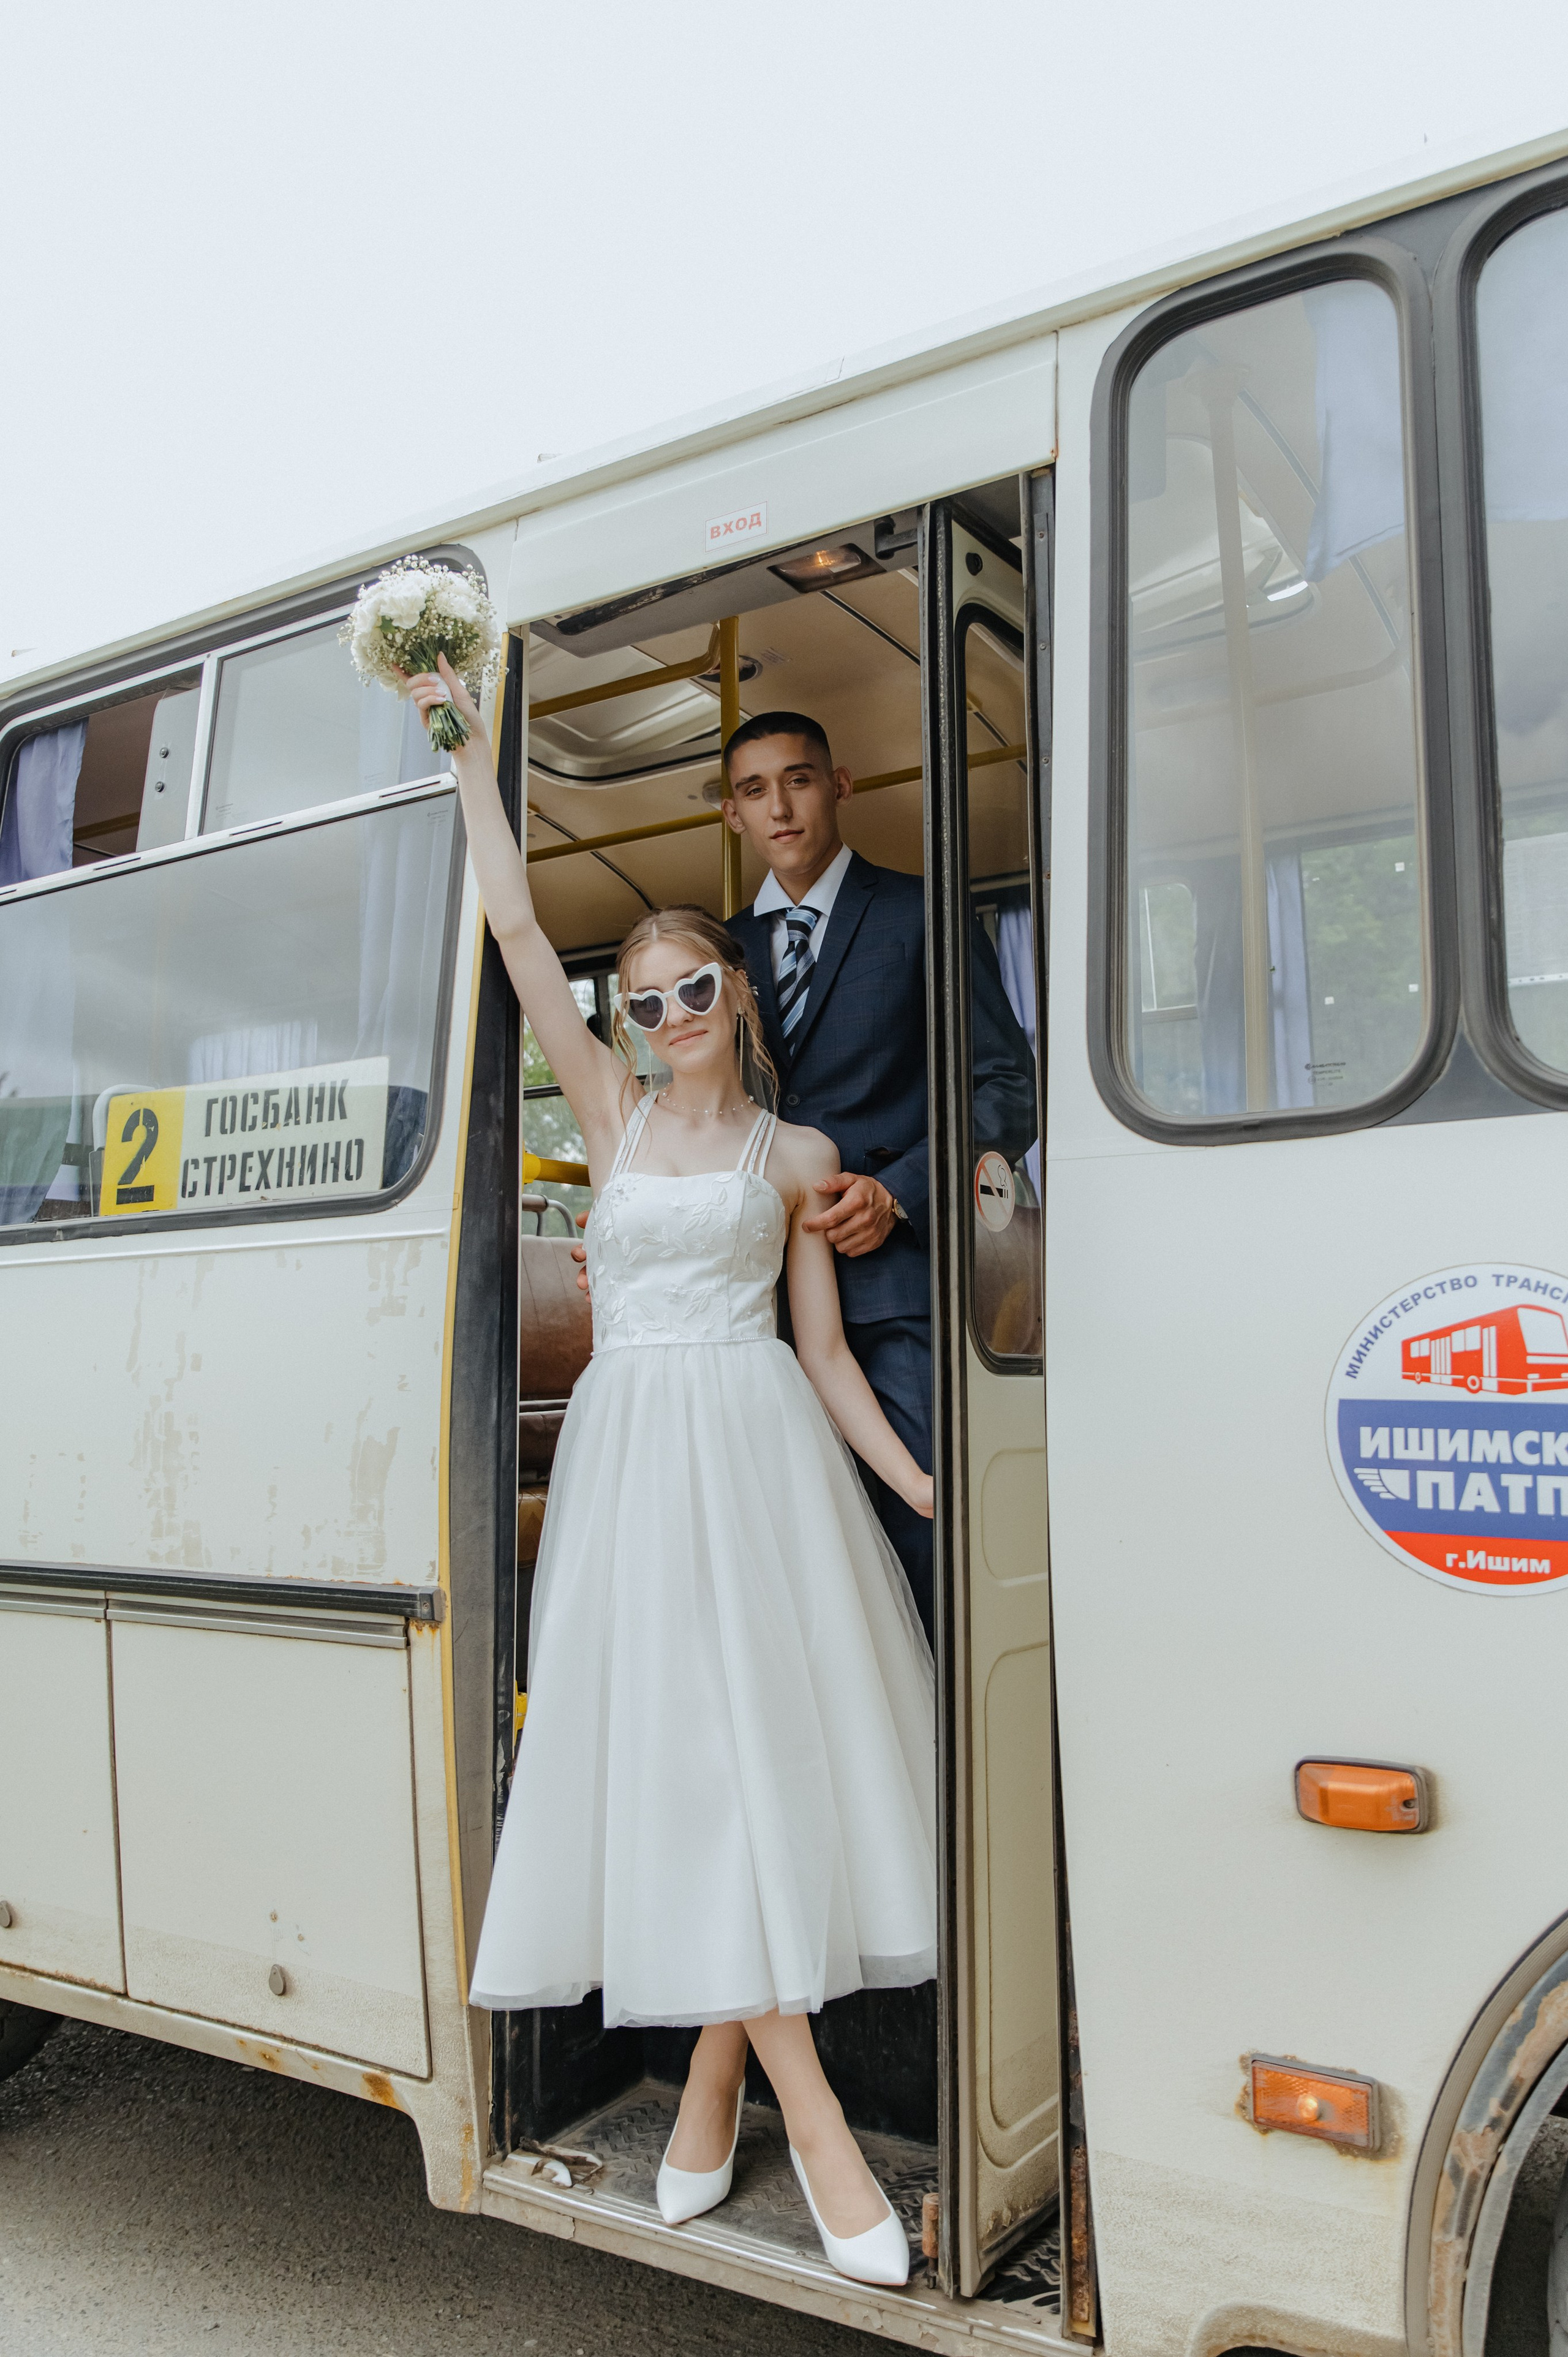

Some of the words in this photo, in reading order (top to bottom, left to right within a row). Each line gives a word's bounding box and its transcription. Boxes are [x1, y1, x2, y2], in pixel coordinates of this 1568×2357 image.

[710, 512, 762, 540] ВХОД
[204, 1079, 349, 1137] ГОСБАНК
[116, 1109, 159, 1205] 2
[181, 1138, 364, 1198] СТРЕХНИНО
[1345, 1275, 1478, 1379] МИНИСТЕРСТВО
[1417, 1470, 1568, 1517] ПАТП
[1446, 1550, 1551, 1575] г.Ишим
